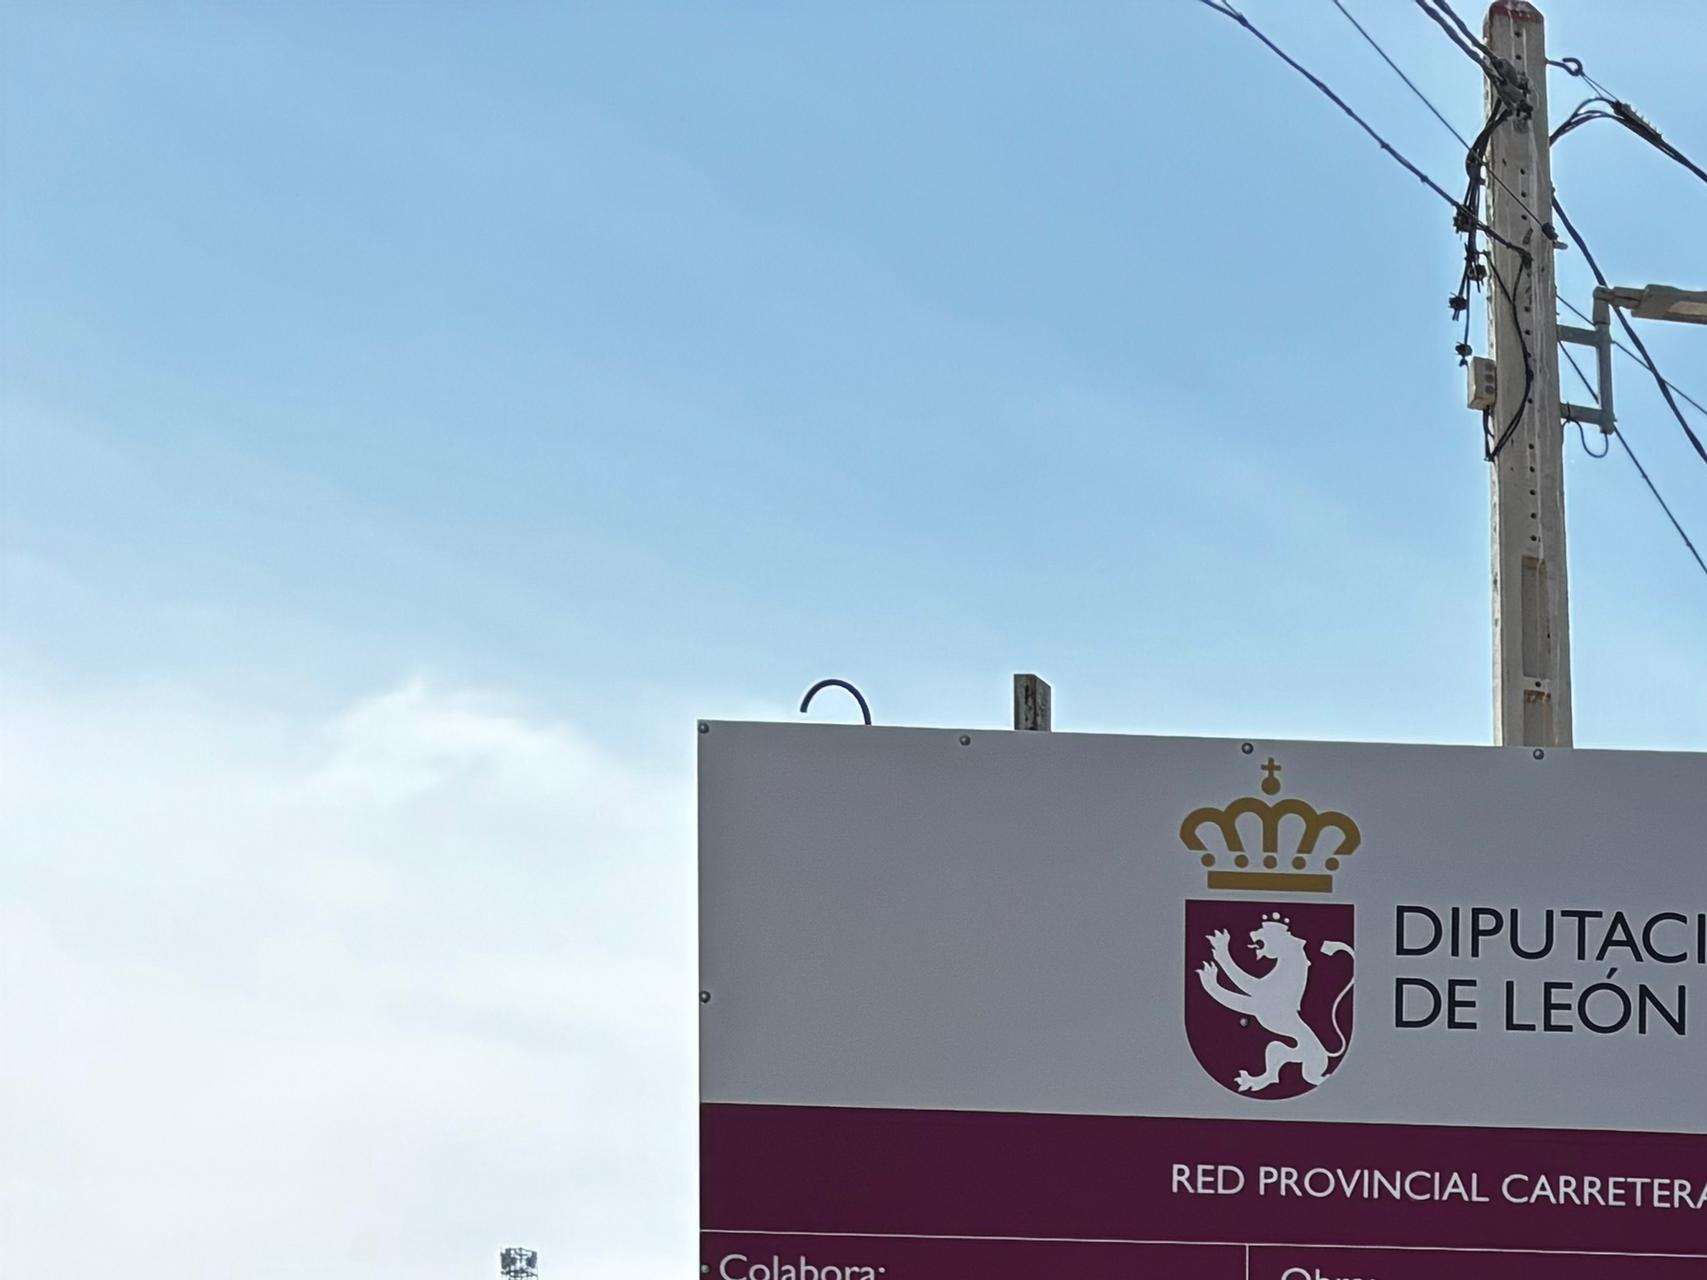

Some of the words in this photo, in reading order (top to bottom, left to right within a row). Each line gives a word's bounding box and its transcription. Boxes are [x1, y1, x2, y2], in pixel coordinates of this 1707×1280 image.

[1394, 977, 1479, 1031] DE
[1505, 966, 1687, 1037] LEÓN
[1171, 1163, 1245, 1195] RED
[1258, 1165, 1490, 1202] PROVINCIAL
